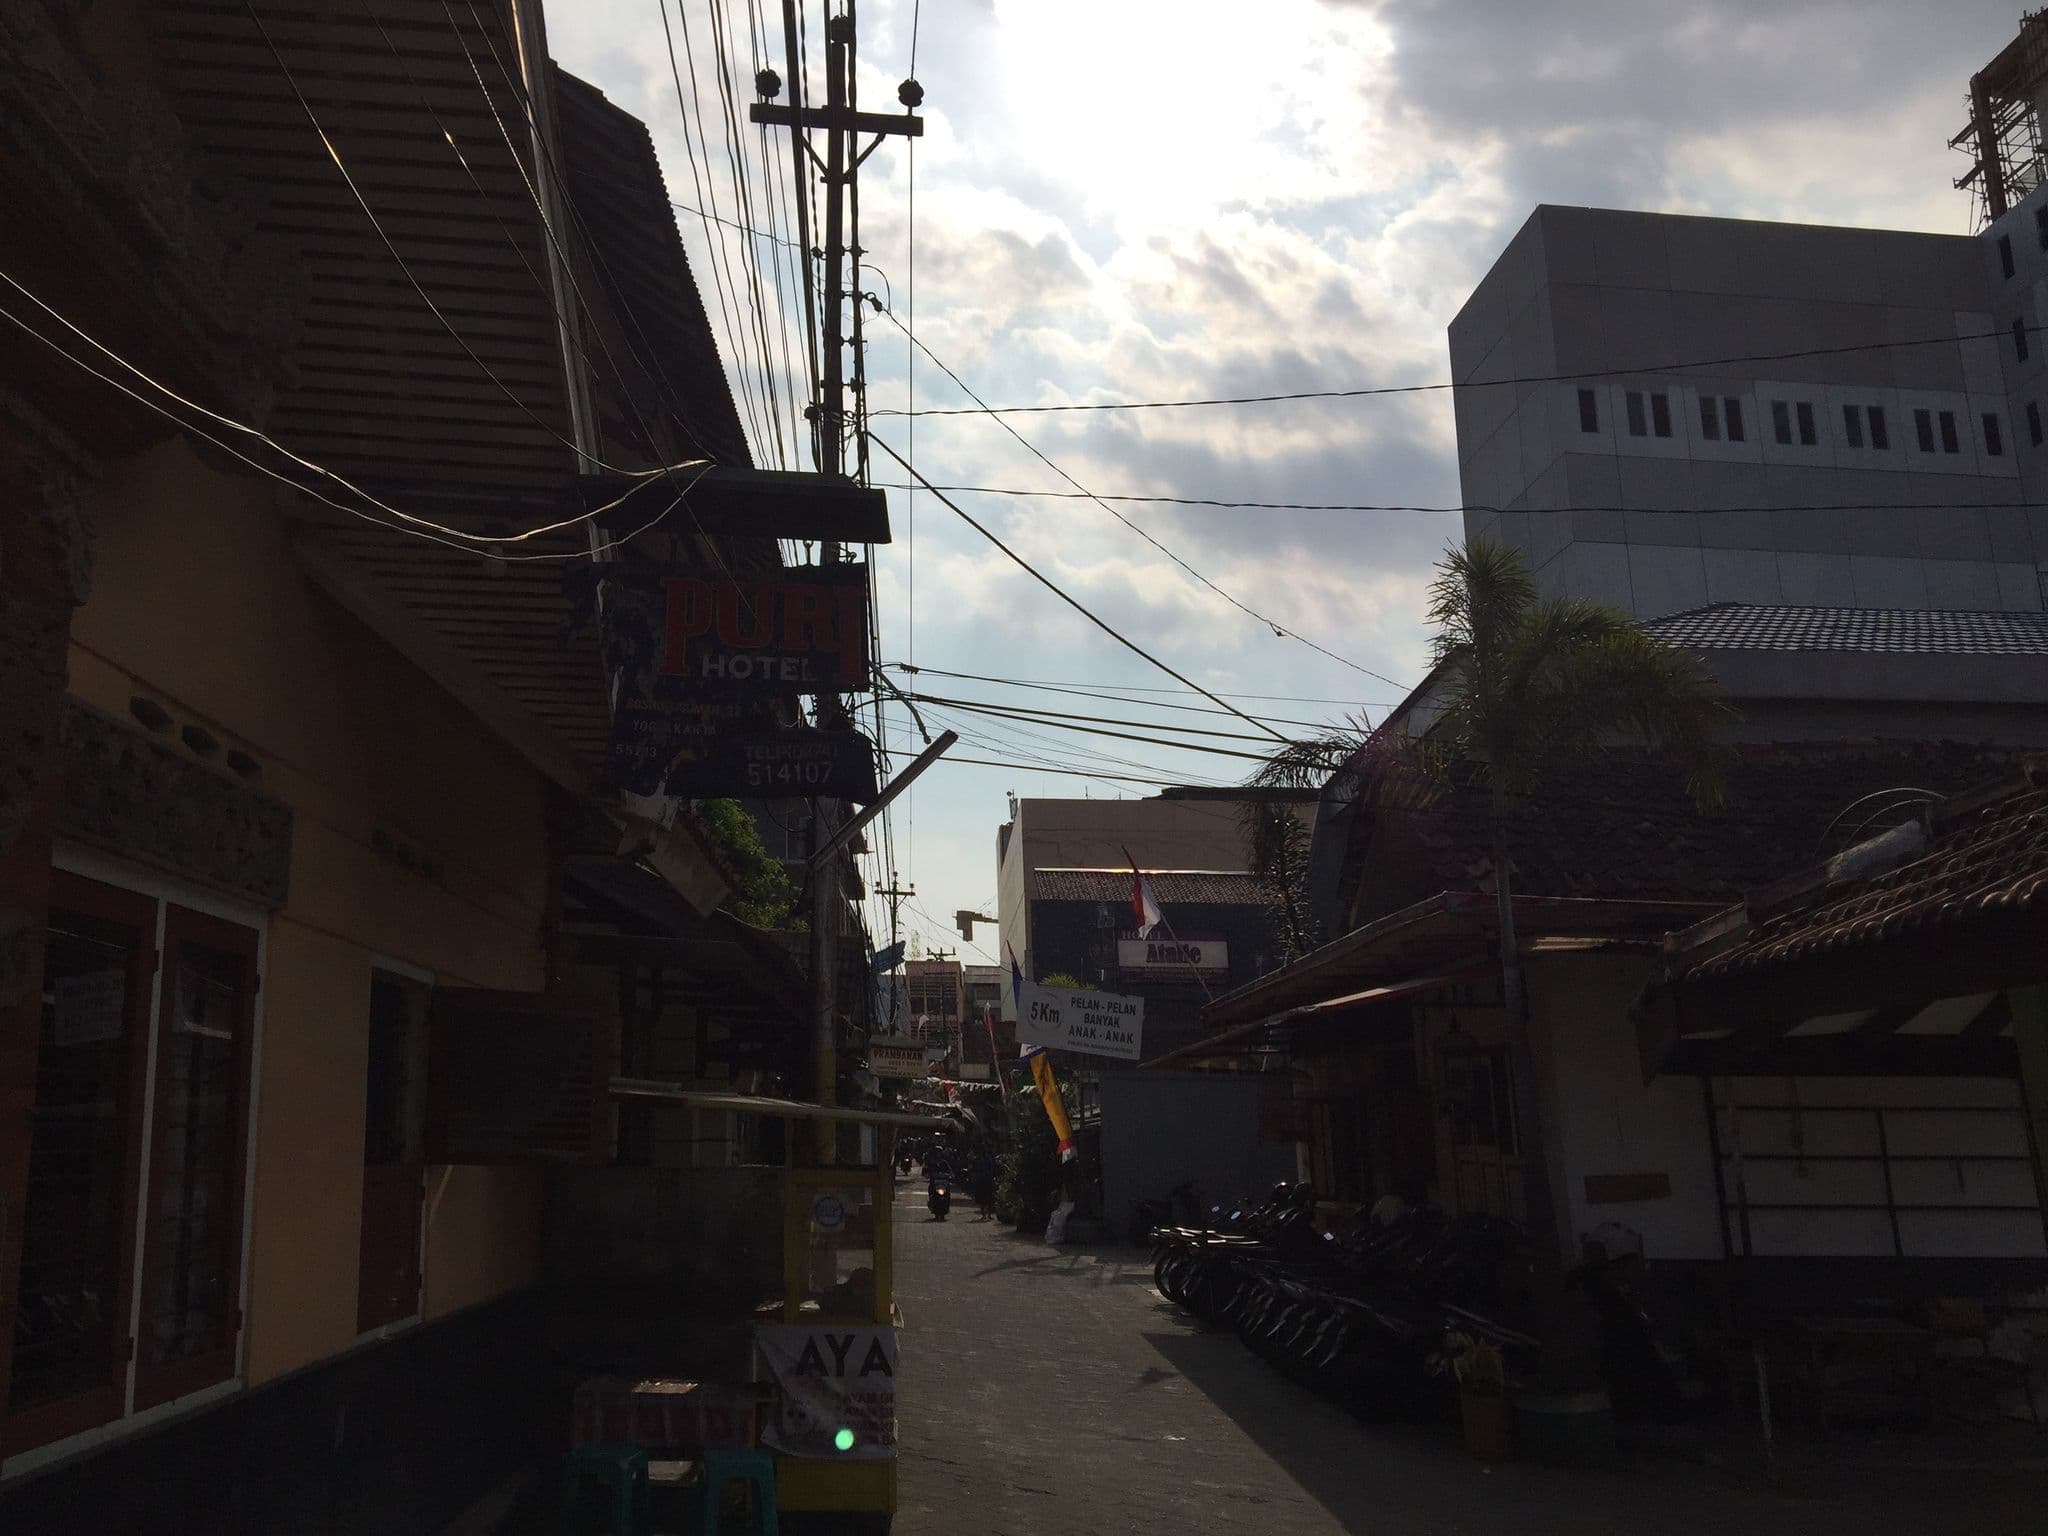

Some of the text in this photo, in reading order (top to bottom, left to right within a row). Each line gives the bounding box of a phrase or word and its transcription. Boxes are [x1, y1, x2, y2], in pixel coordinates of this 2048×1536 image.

[657, 577, 867, 687] PURI
[701, 654, 818, 682] HOTEL
[747, 762, 833, 785] 514107
[1070, 996, 1099, 1010] PELAN
[1106, 1001, 1137, 1016] PELAN
[1083, 1013, 1120, 1028] BANYAK
[1068, 1025, 1097, 1040] ANAK
[1105, 1030, 1134, 1044] ANAK
